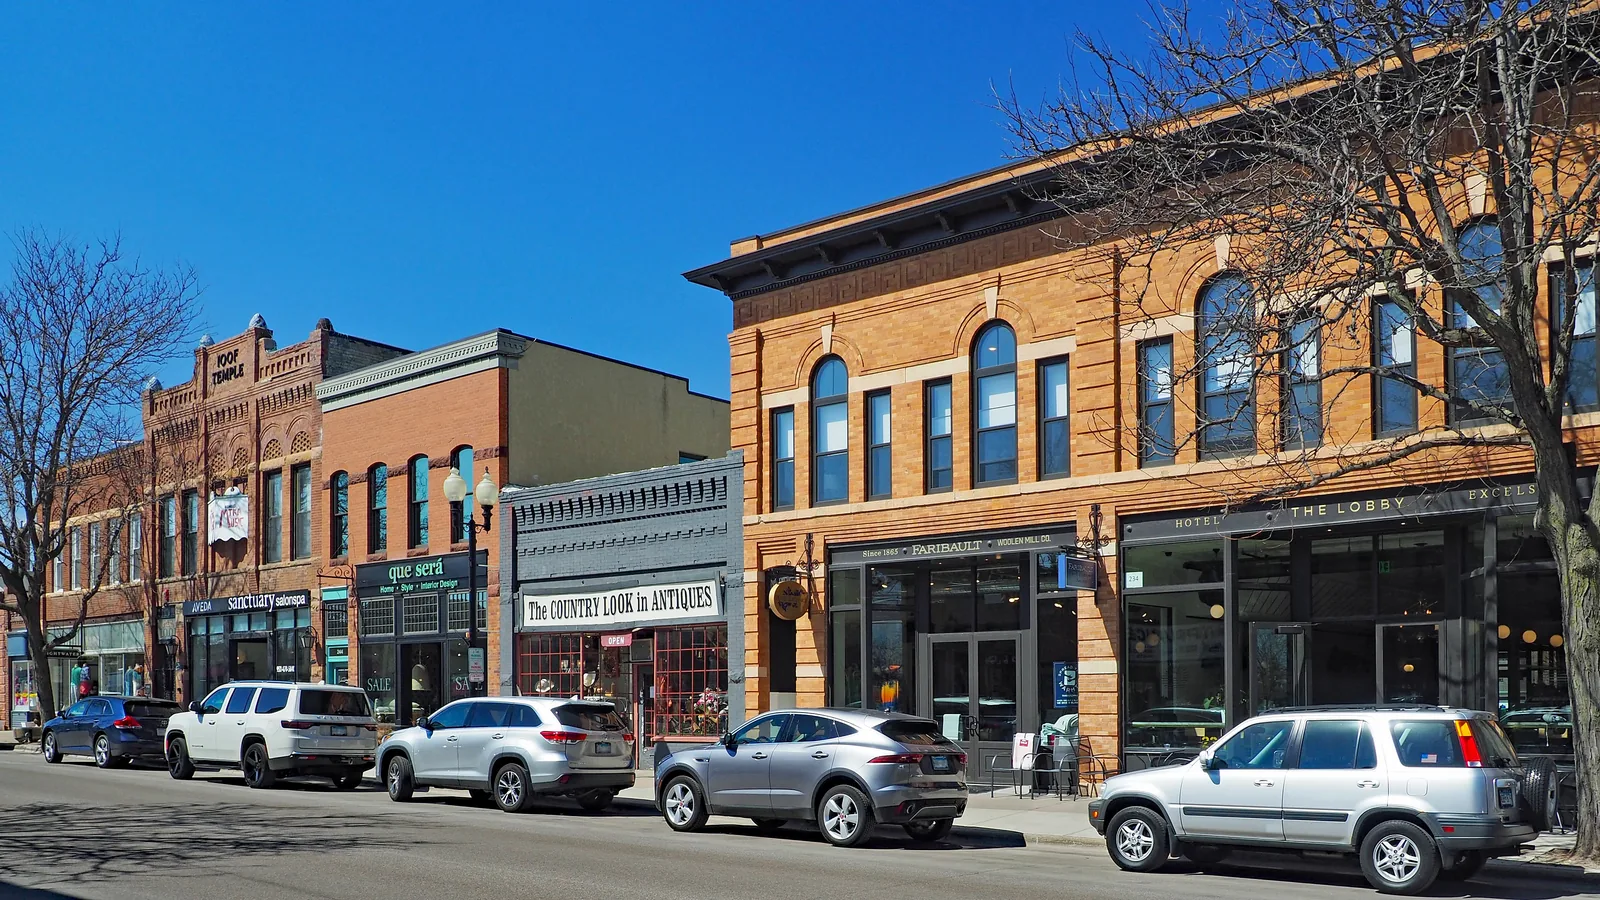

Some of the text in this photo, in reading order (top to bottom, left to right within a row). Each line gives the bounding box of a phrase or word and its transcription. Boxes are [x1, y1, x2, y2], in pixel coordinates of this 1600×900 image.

[212, 363, 244, 385] TEMPLE
[1175, 484, 1536, 528] HOTEL THE LOBBY EXCELS
[862, 534, 1052, 558] Since 1865 FARIBAULT WOOLEN MILL CO.
[388, 557, 443, 584] que será
[380, 579, 458, 594] Home Style Interior Design
[192, 593, 306, 613] AVEDA sanctuary salonspa
[528, 585, 713, 621] The COUNTRY LOOK in ANTIQUES
[608, 636, 625, 645] OPEN
[367, 677, 391, 692] SALE
